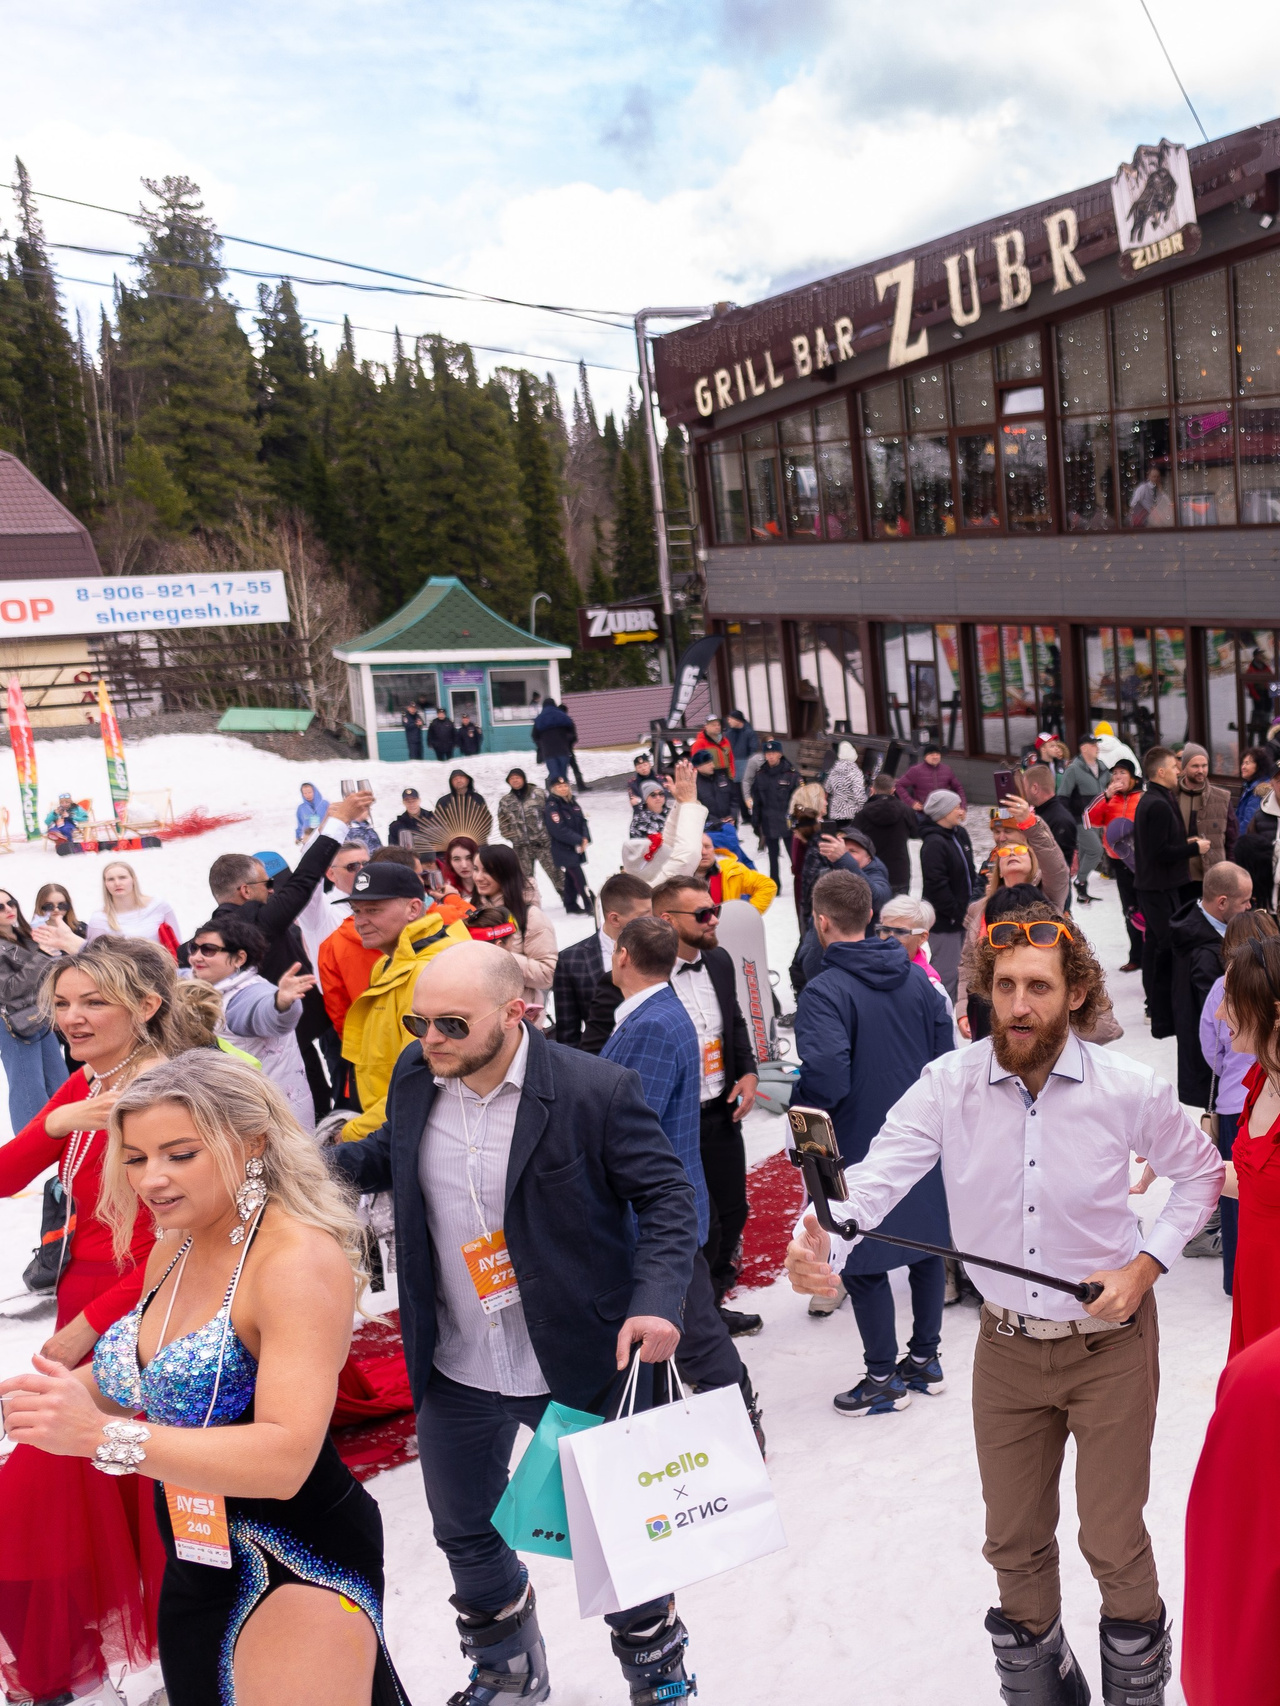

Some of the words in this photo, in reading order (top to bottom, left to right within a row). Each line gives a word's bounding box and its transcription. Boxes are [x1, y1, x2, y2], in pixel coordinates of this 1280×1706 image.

[1130, 231, 1184, 270] ZUBR
[695, 349, 784, 416] GRILL
[793, 315, 854, 378] BAR
[875, 207, 1087, 368] ZUBR
[76, 581, 272, 602] 8-906-921-17-55
[96, 601, 261, 625] sheregesh.biz
[586, 608, 659, 637] ZUBR
[177, 1495, 216, 1517] AYS!
[675, 1496, 729, 1529] 2ГИС
[187, 1521, 211, 1536] 240
